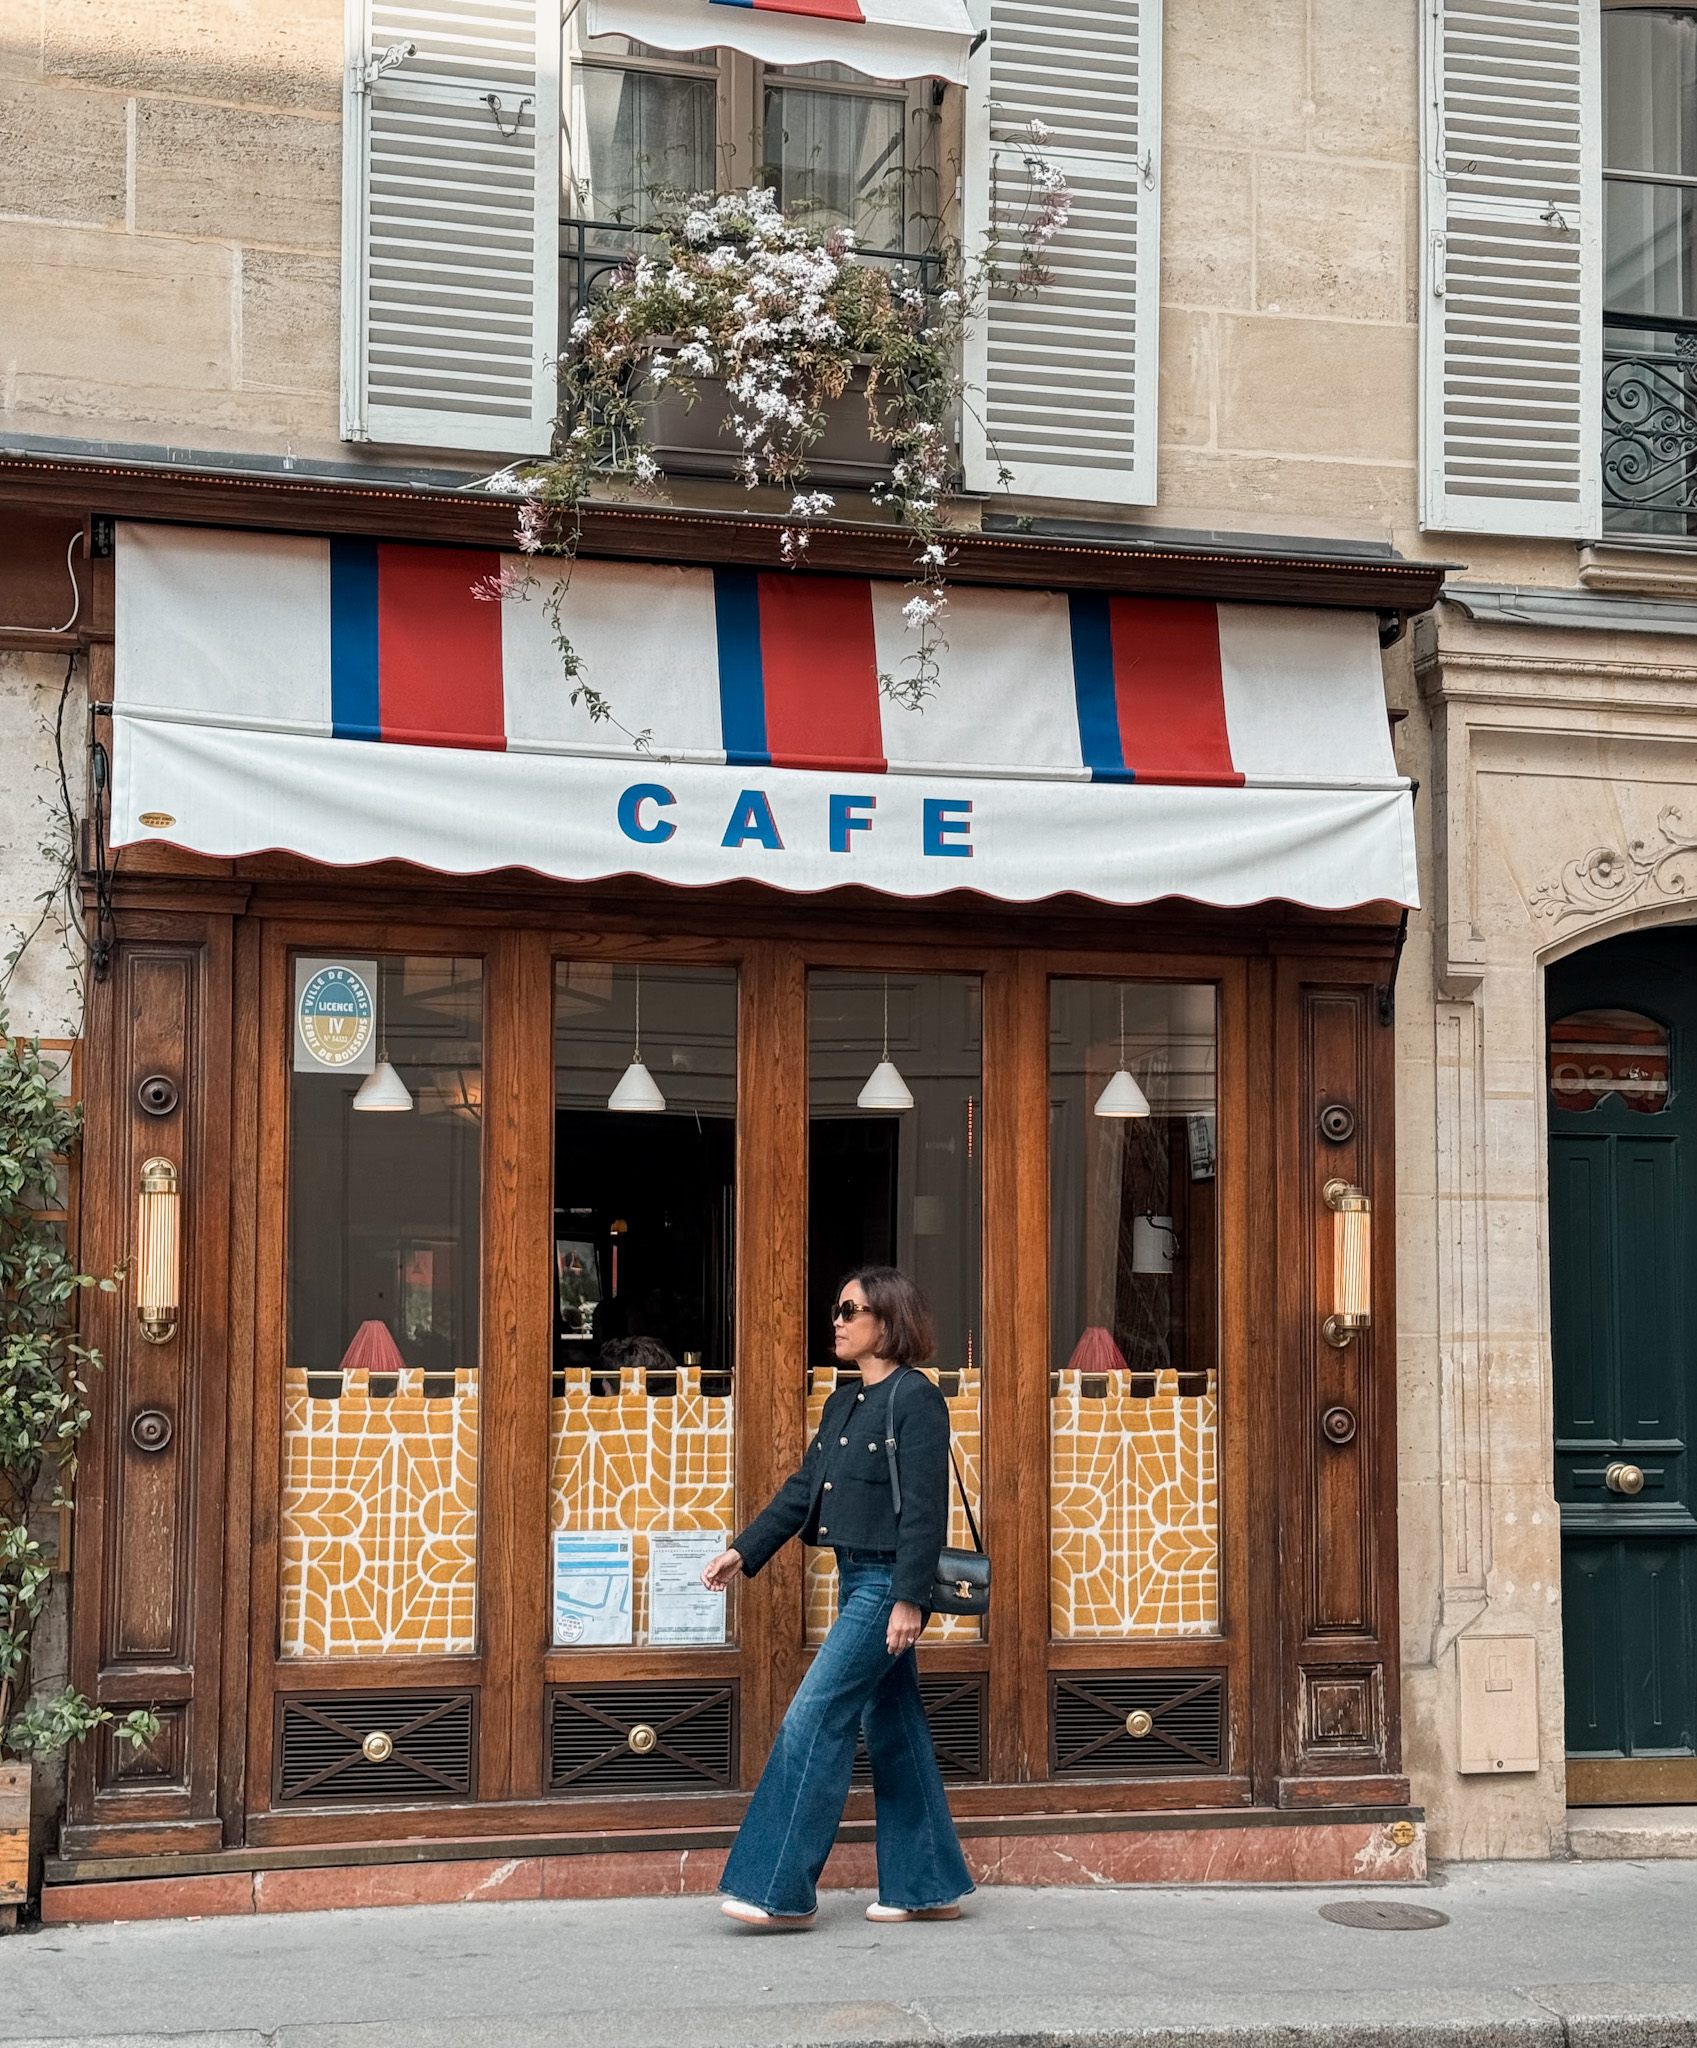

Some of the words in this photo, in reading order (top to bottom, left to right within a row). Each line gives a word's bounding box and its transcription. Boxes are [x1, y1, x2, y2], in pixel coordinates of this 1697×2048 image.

[617, 783, 974, 858] CAFE
[305, 977, 326, 1007] VILLE
[328, 971, 343, 980] DE
[346, 977, 368, 1009] PARIS
[318, 1001, 354, 1012] LICENCE
[304, 1016, 320, 1048] DEBIT
[318, 1047, 333, 1061] DE
[334, 1018, 368, 1062] BOISSONS
[329, 1018, 344, 1034] IV
